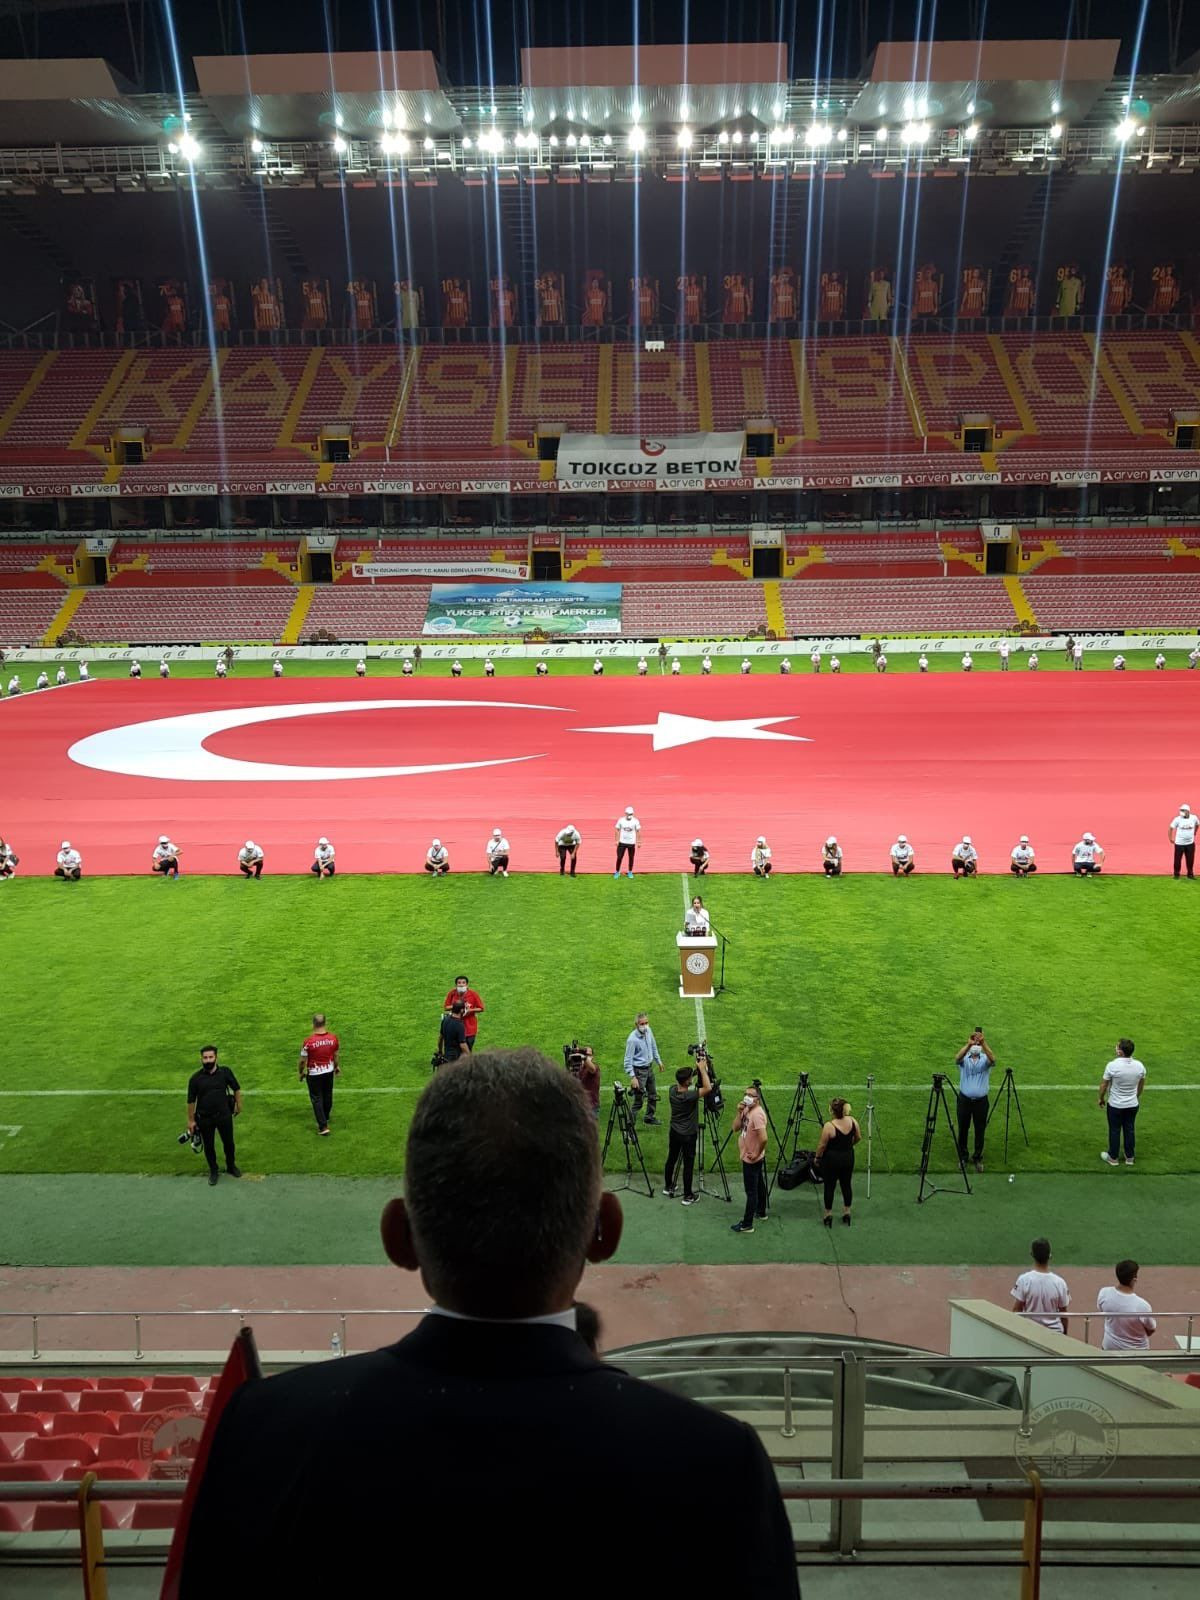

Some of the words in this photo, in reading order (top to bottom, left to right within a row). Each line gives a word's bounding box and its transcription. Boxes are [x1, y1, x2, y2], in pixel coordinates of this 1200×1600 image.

[666, 460, 737, 475] BETON
[965, 473, 999, 482] arven
[1015, 472, 1049, 481] arven
[1064, 471, 1098, 480] arven
[1113, 470, 1148, 479] arven
[1164, 469, 1198, 478] arven
[620, 479, 654, 488] arven
[669, 479, 703, 488] arven
[717, 478, 751, 487] arven
[767, 478, 800, 486] arven
[816, 476, 850, 485] arven
[866, 475, 899, 484] arven
[915, 475, 949, 483] arven
[36, 485, 69, 493] arven
[84, 484, 118, 493] arven
[133, 483, 166, 492] arven
[182, 483, 215, 492] arven
[231, 483, 264, 491] arven
[279, 482, 313, 491] arven
[329, 482, 362, 491] arven
[377, 481, 411, 490] arven
[426, 481, 459, 490] arven
[475, 481, 508, 489] arven
[524, 480, 556, 489] arven
[573, 480, 606, 489] arven
[523, 609, 556, 617] KAMP
